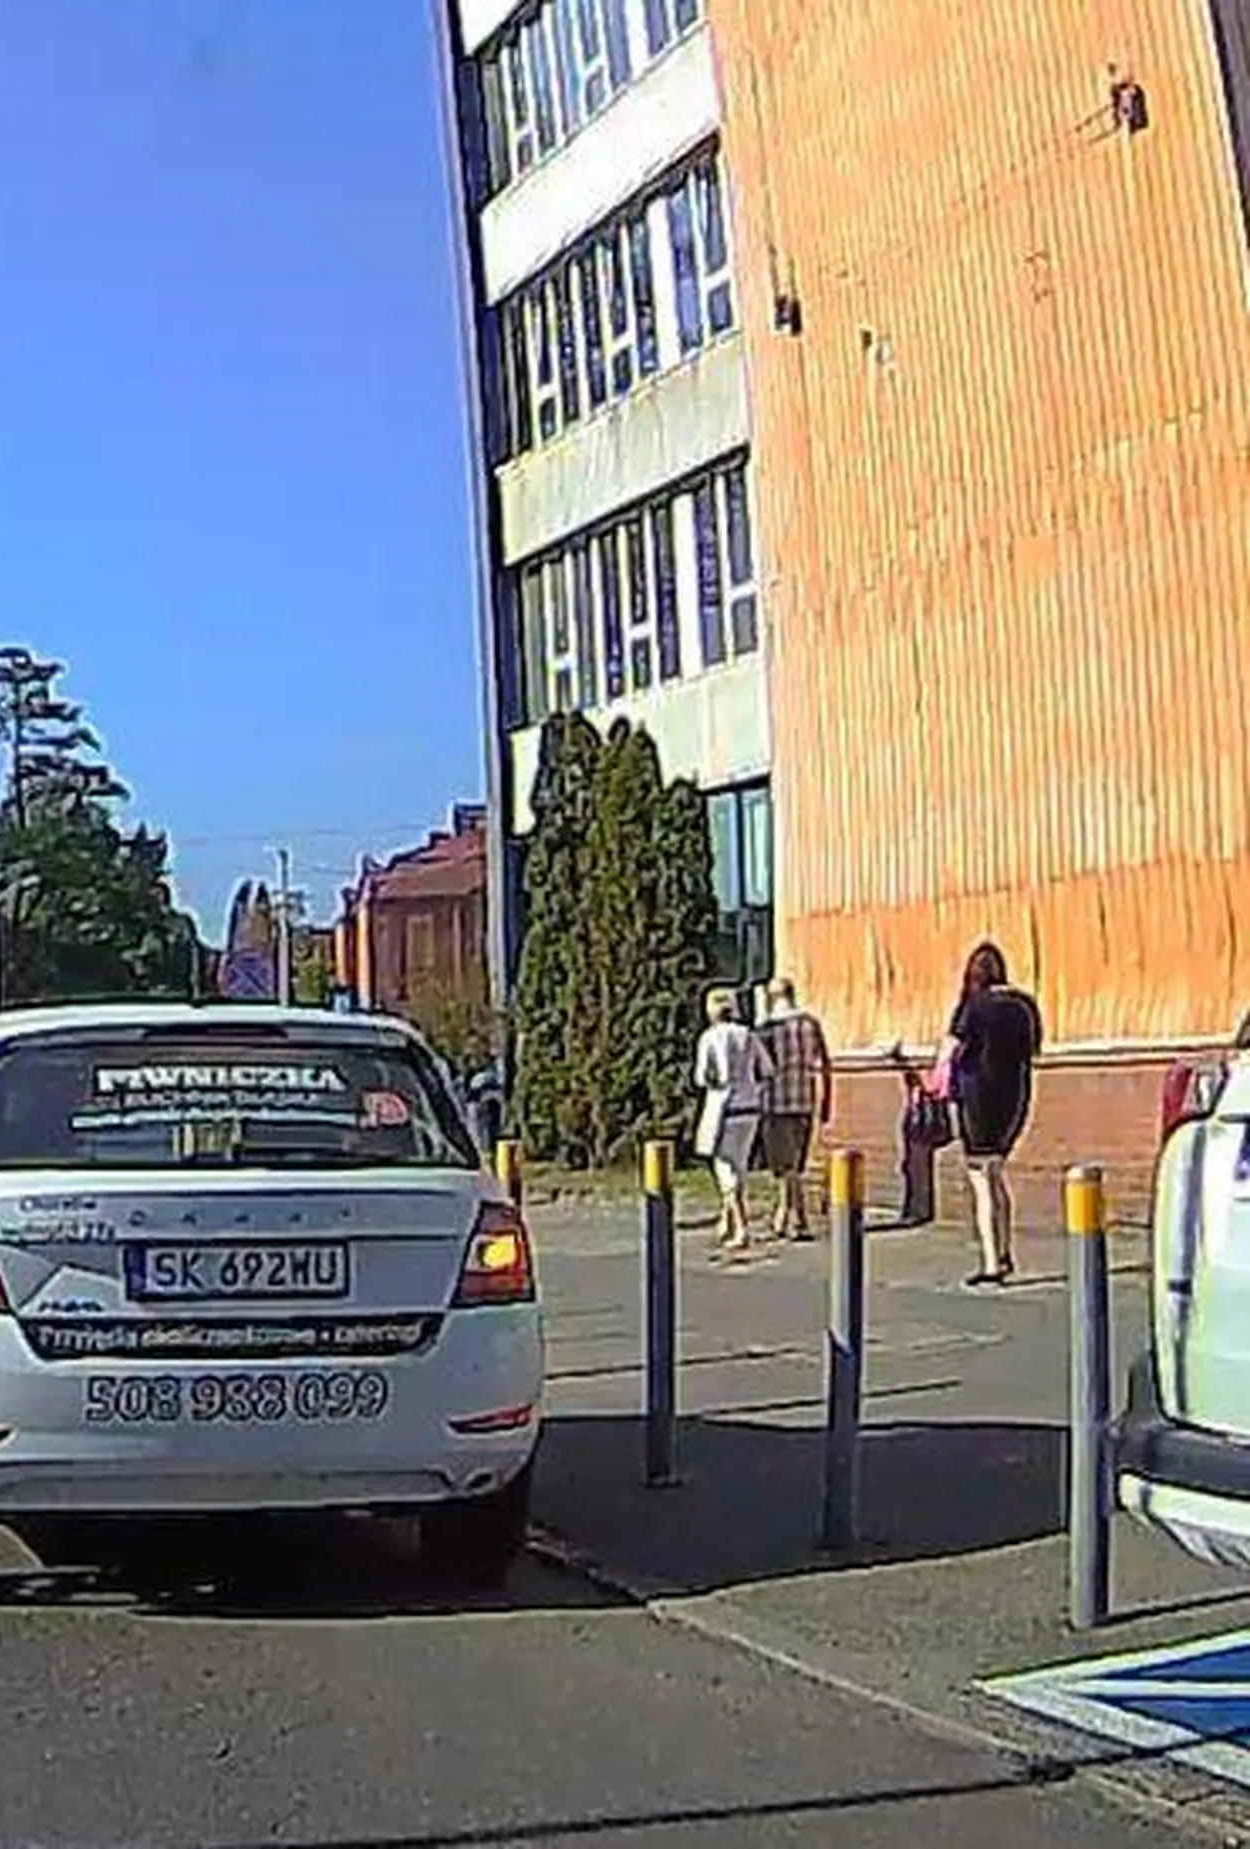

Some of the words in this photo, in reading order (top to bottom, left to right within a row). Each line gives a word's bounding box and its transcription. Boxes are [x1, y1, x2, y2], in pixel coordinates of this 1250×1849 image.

[96, 1065, 348, 1092] PIWNICZKA
[155, 1251, 203, 1288] SK
[220, 1251, 337, 1288] 692WU
[85, 1374, 181, 1422] 508
[189, 1373, 289, 1422] 988
[293, 1370, 390, 1421] 099
